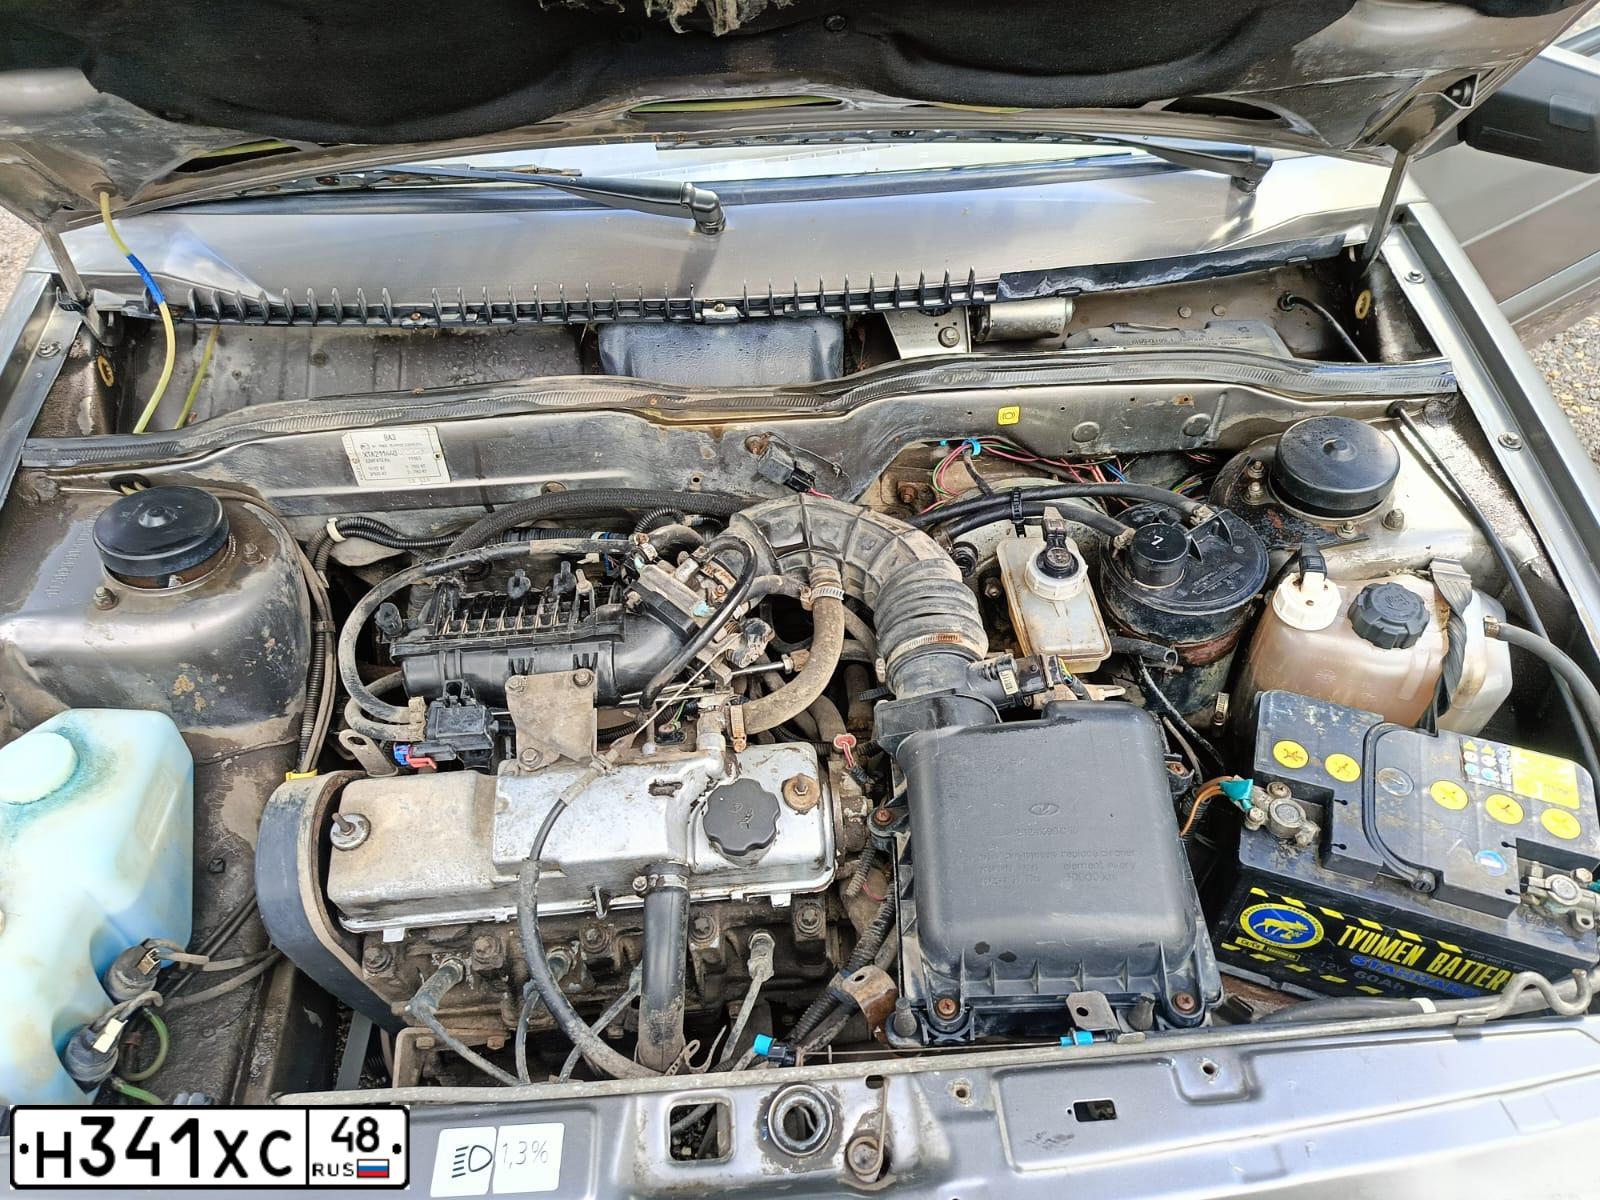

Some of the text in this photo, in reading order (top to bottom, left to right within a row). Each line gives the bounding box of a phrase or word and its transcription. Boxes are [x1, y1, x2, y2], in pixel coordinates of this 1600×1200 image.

[1337, 925, 1419, 967] TYUMEN
[1426, 951, 1518, 992] BATTER
[501, 1140, 549, 1167] 1,3%
